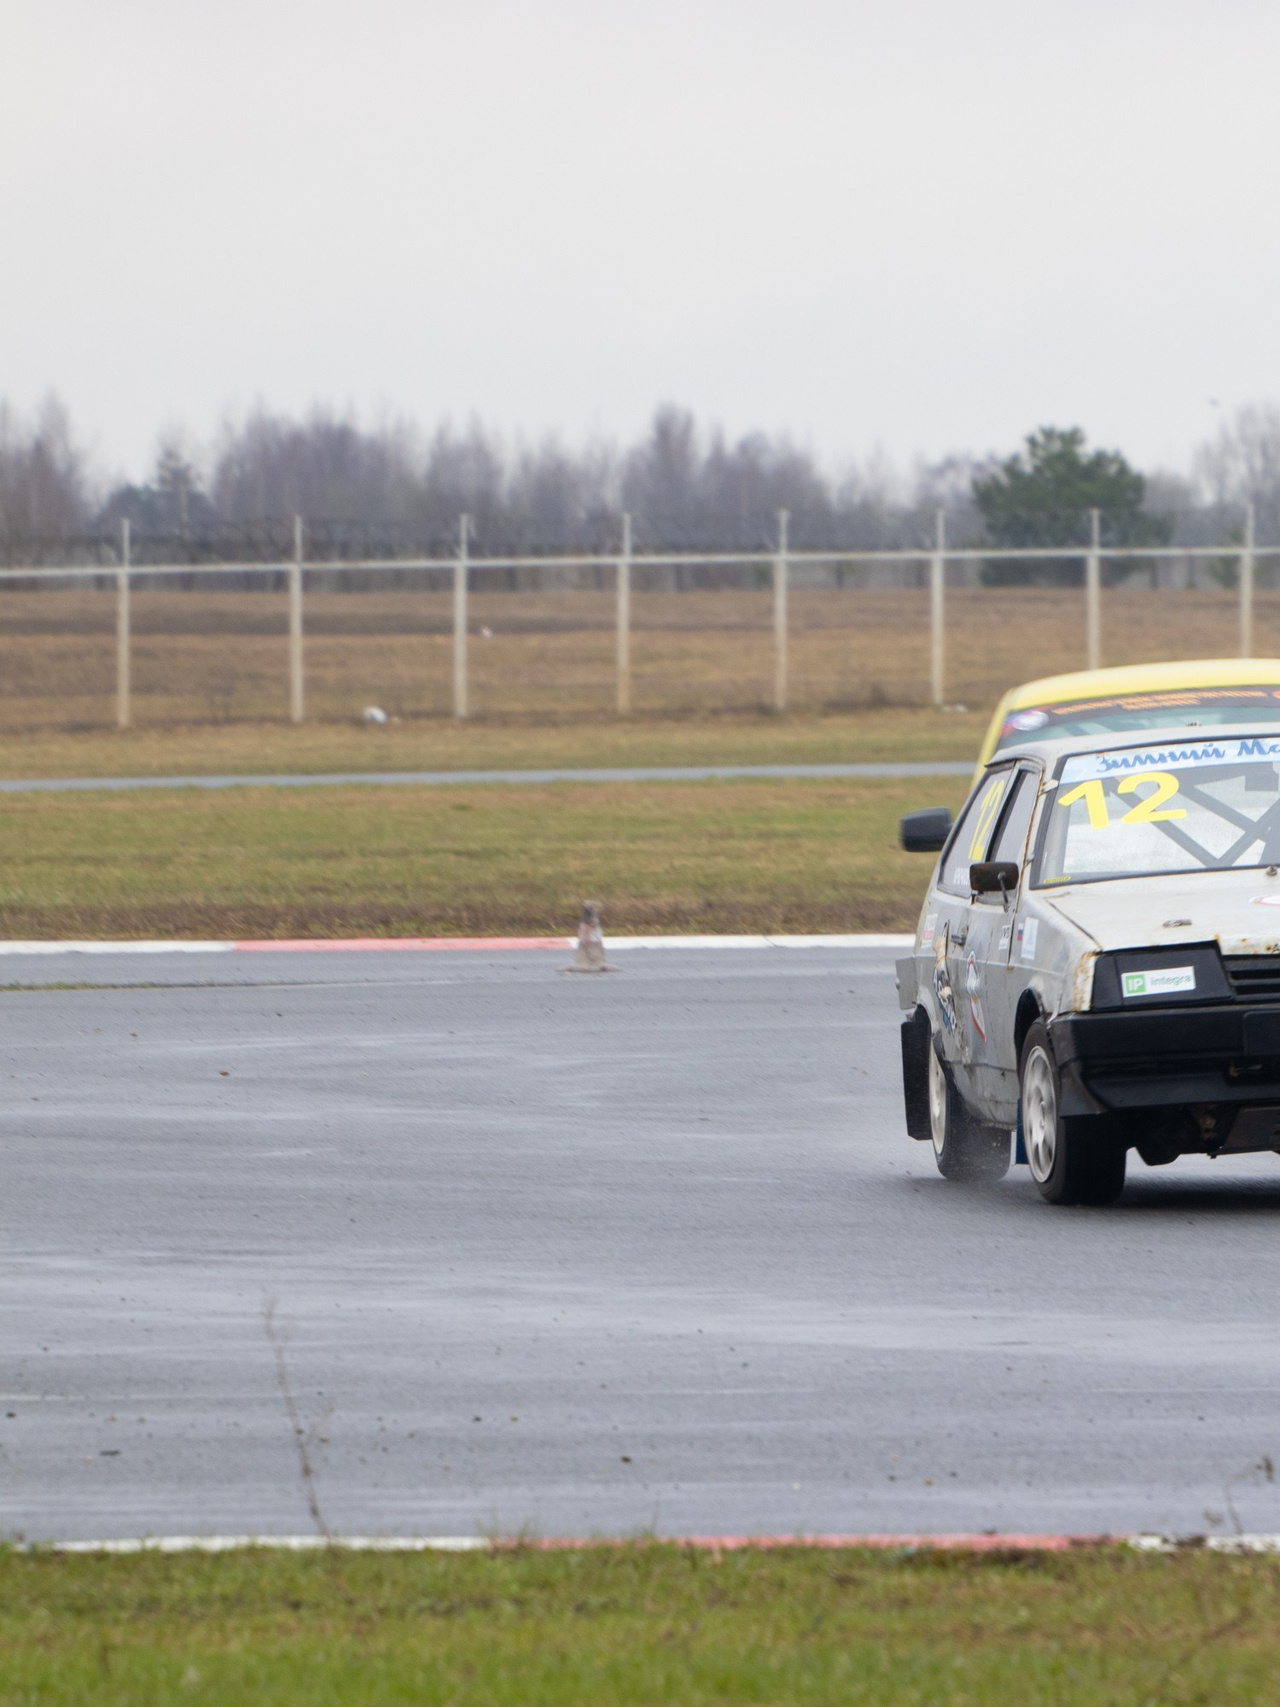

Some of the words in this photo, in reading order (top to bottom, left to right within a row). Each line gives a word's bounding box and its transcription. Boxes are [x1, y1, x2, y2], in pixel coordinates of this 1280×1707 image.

[1096, 743, 1226, 772] Зимний
[968, 779, 1005, 861] 12
[1058, 771, 1187, 829] 12
[1127, 977, 1144, 992] IP
[1150, 975, 1191, 986] integra
